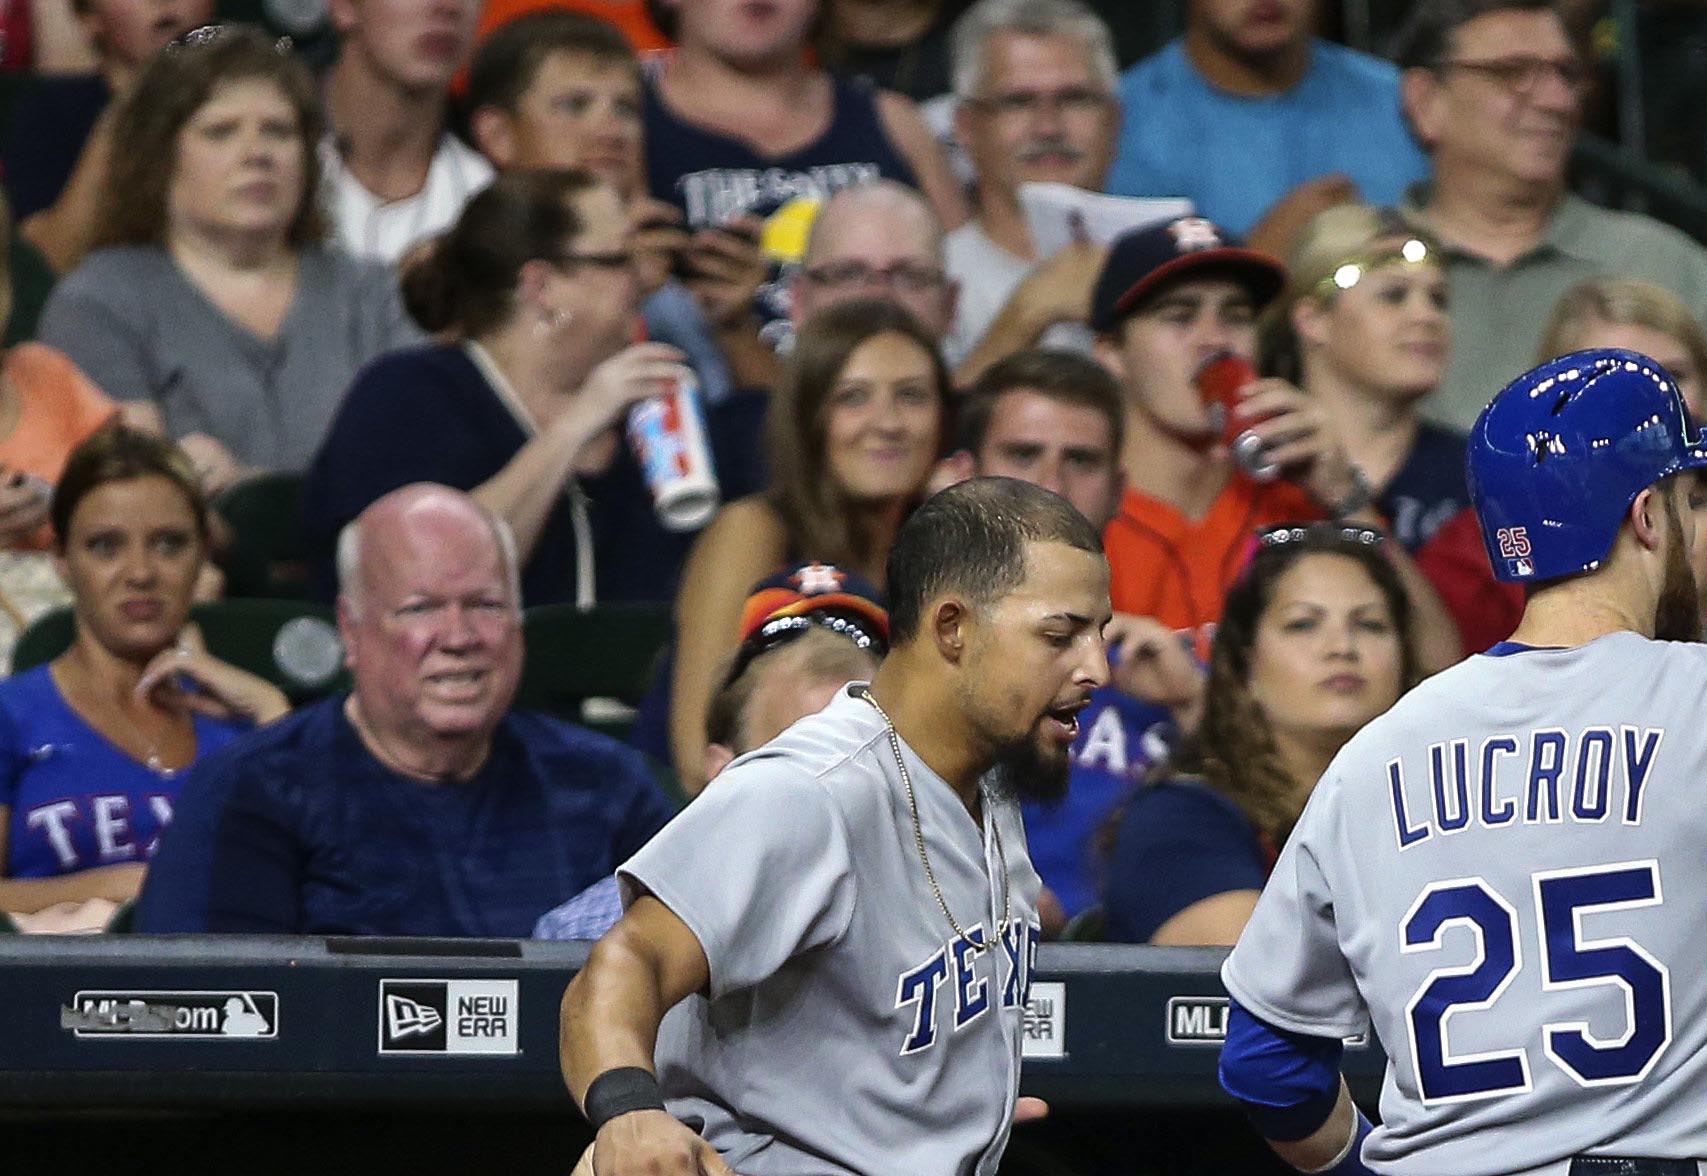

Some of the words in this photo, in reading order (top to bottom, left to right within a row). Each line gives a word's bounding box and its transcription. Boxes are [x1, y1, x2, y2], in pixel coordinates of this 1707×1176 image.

[1496, 526, 1532, 558] 25
[1386, 723, 1665, 852] LUCROY
[1400, 858, 1673, 1106] 25
[458, 996, 507, 1016] NEW
[458, 1017, 507, 1037] ERA
[1023, 1020, 1053, 1040] RA
